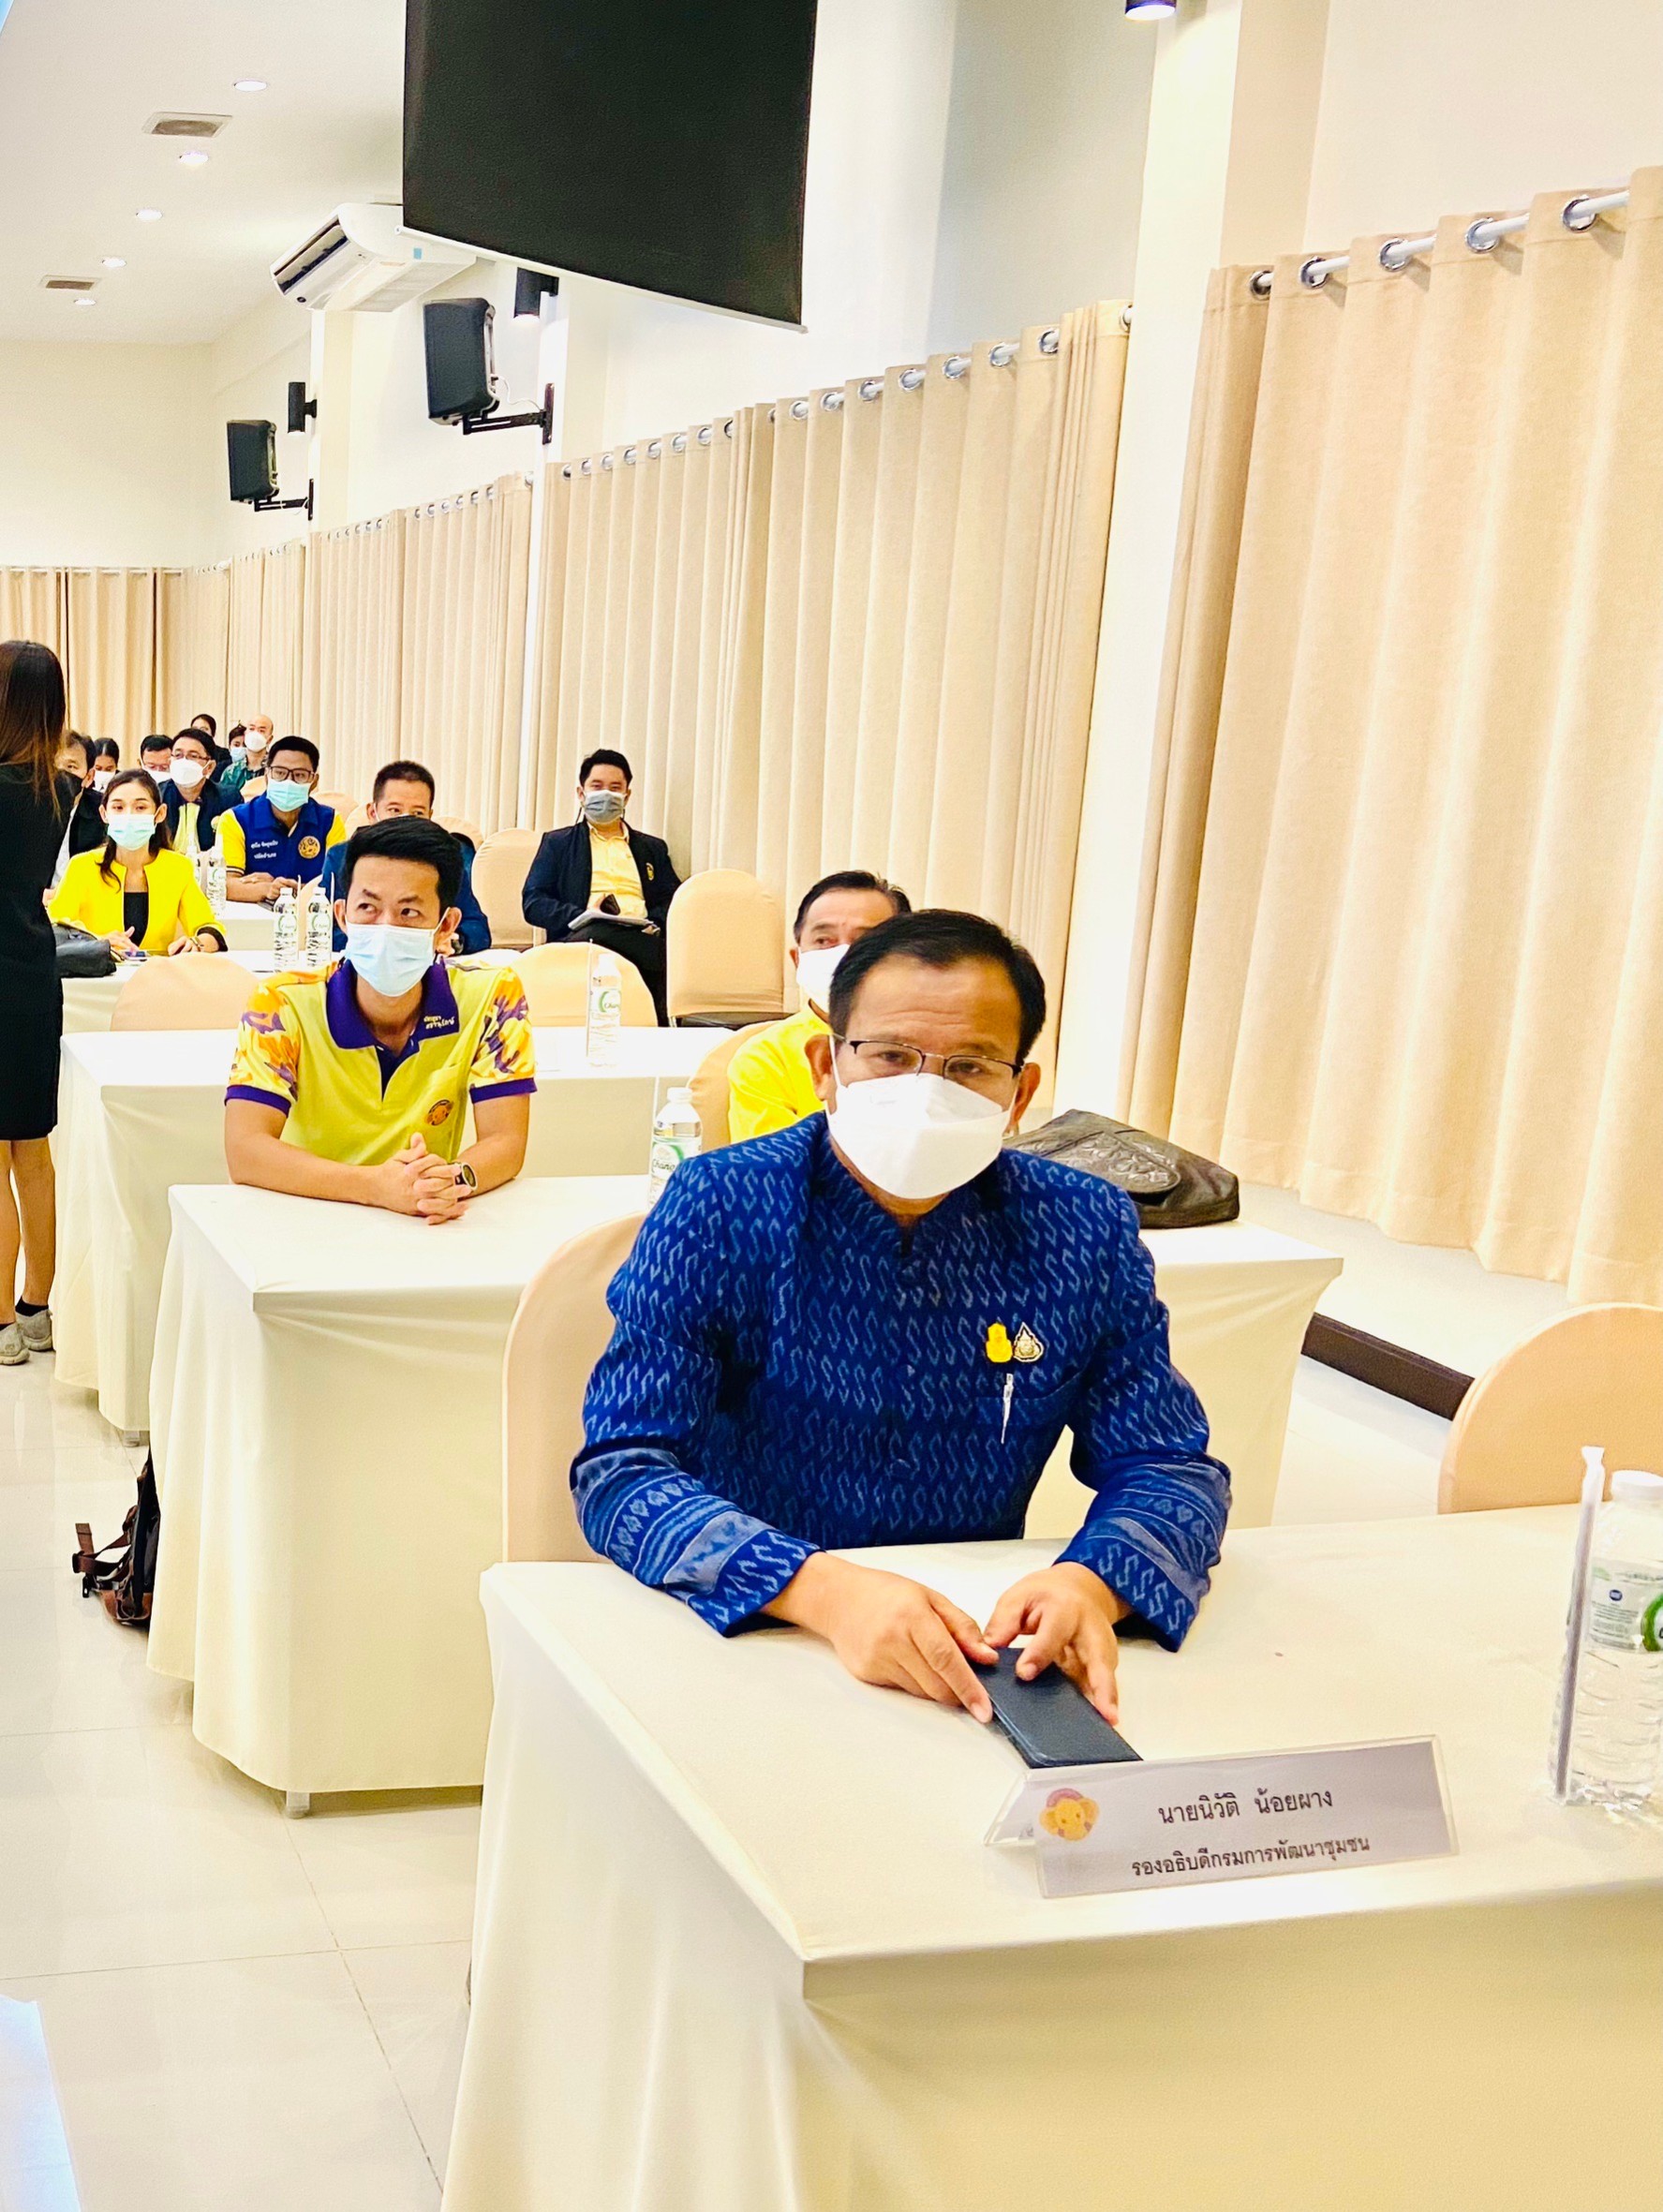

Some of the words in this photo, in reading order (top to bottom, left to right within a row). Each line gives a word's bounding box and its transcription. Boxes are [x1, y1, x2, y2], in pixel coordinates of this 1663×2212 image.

[1158, 1791, 1240, 1824] นายนิวัติ
[1255, 1787, 1333, 1814] น้อยผาง
[1132, 1837, 1371, 1877] รองอธิบดีกรมการพัฒนาชุมชน
